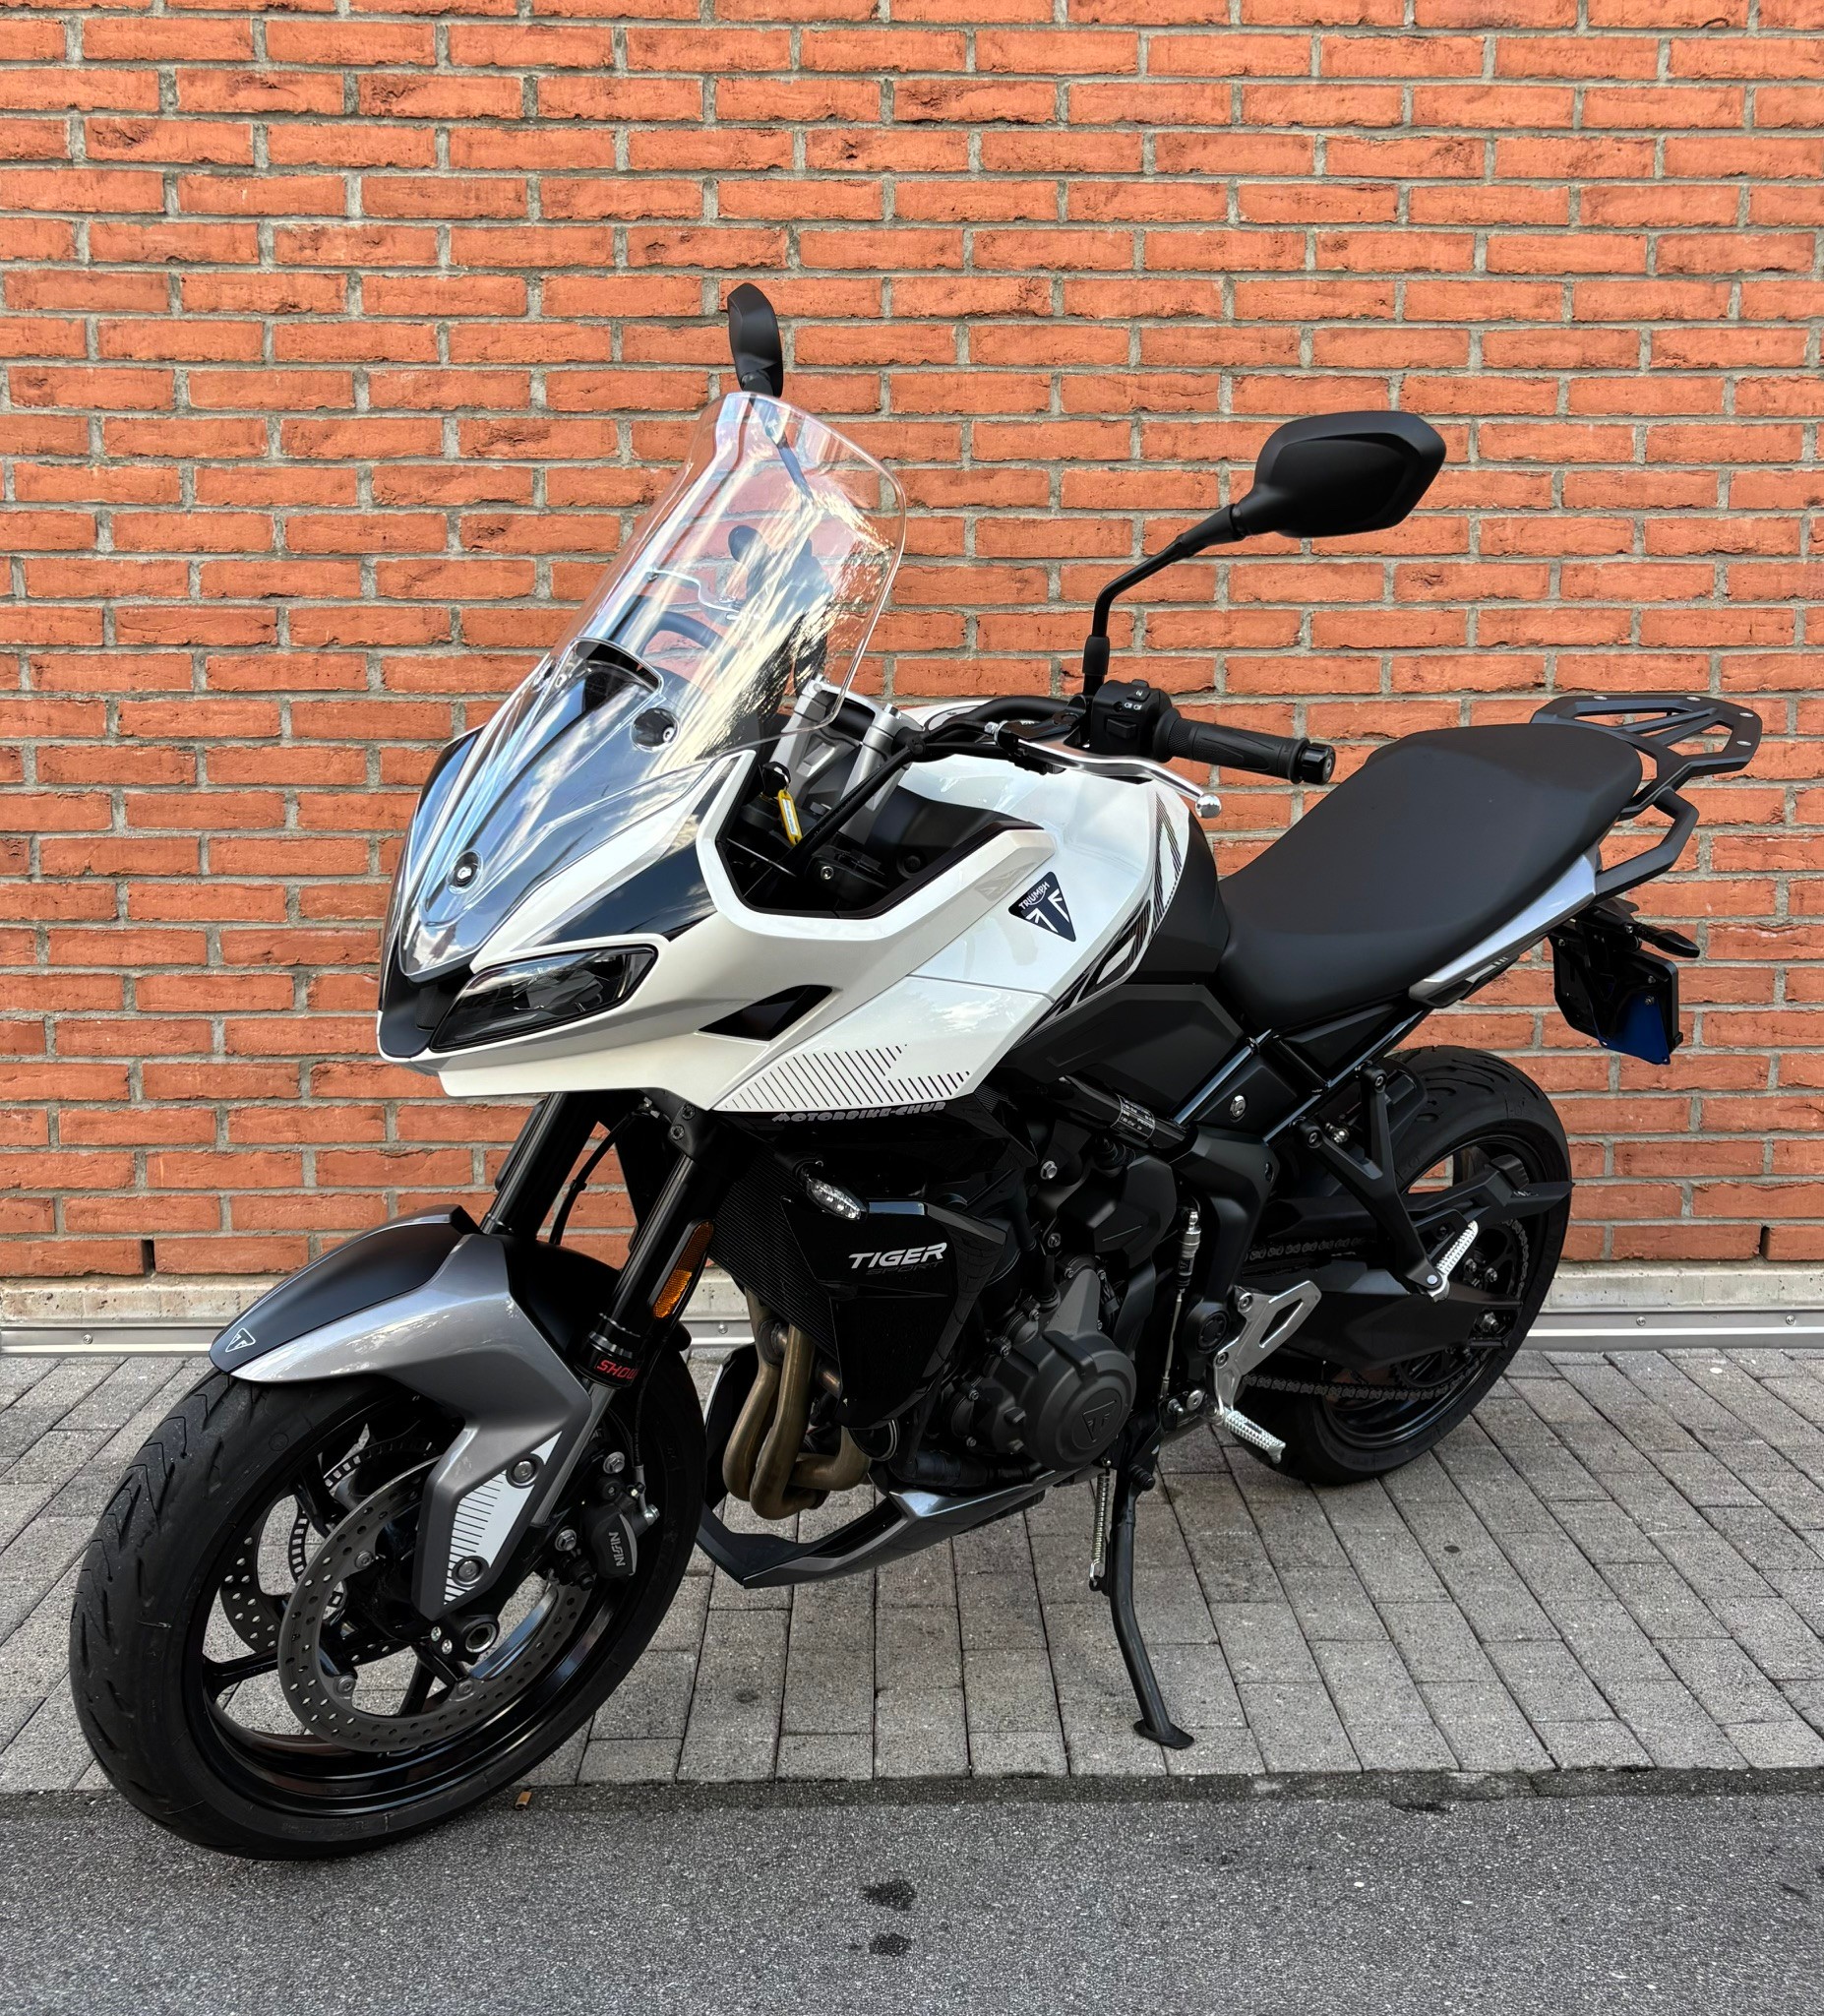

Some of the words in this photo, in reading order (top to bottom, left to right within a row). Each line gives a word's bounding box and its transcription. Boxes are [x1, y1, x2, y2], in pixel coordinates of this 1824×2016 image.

[1018, 881, 1051, 910] TRIUMPH
[771, 1101, 946, 1123] MOTORBIKE-CHUR
[848, 1242, 947, 1269] TIGER
[596, 1359, 640, 1379] SHOW
